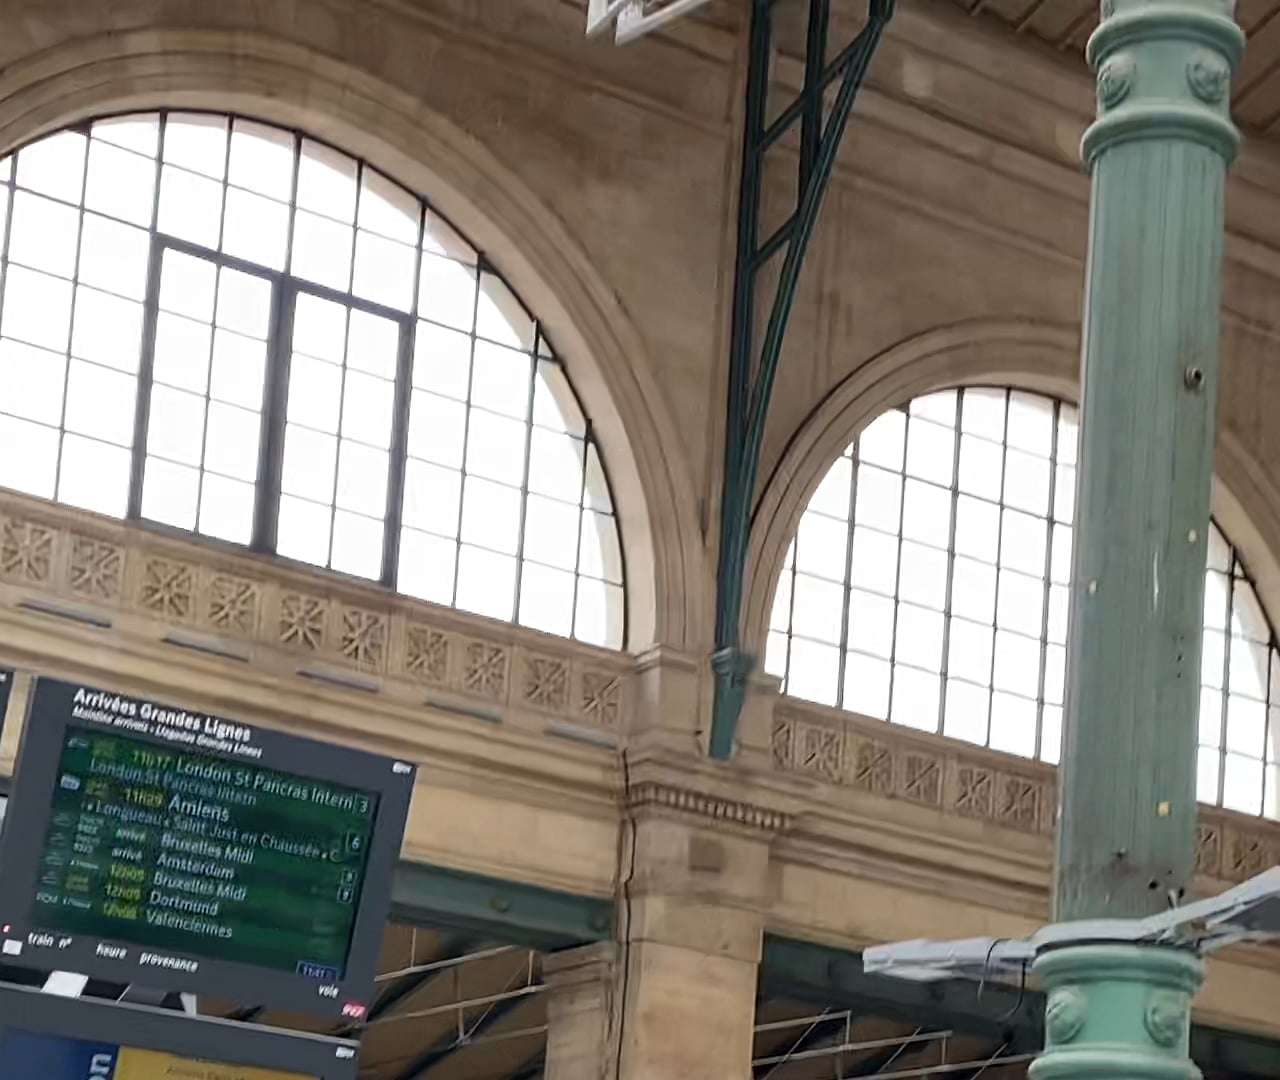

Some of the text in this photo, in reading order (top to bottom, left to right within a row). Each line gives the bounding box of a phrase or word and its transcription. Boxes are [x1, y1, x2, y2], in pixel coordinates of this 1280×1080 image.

[73, 687, 251, 743] Arrivées Grandes Lignes
[176, 757, 231, 782] London
[168, 793, 230, 822] Amiens
[224, 845, 256, 865] Midi
[217, 884, 248, 902] Midi
